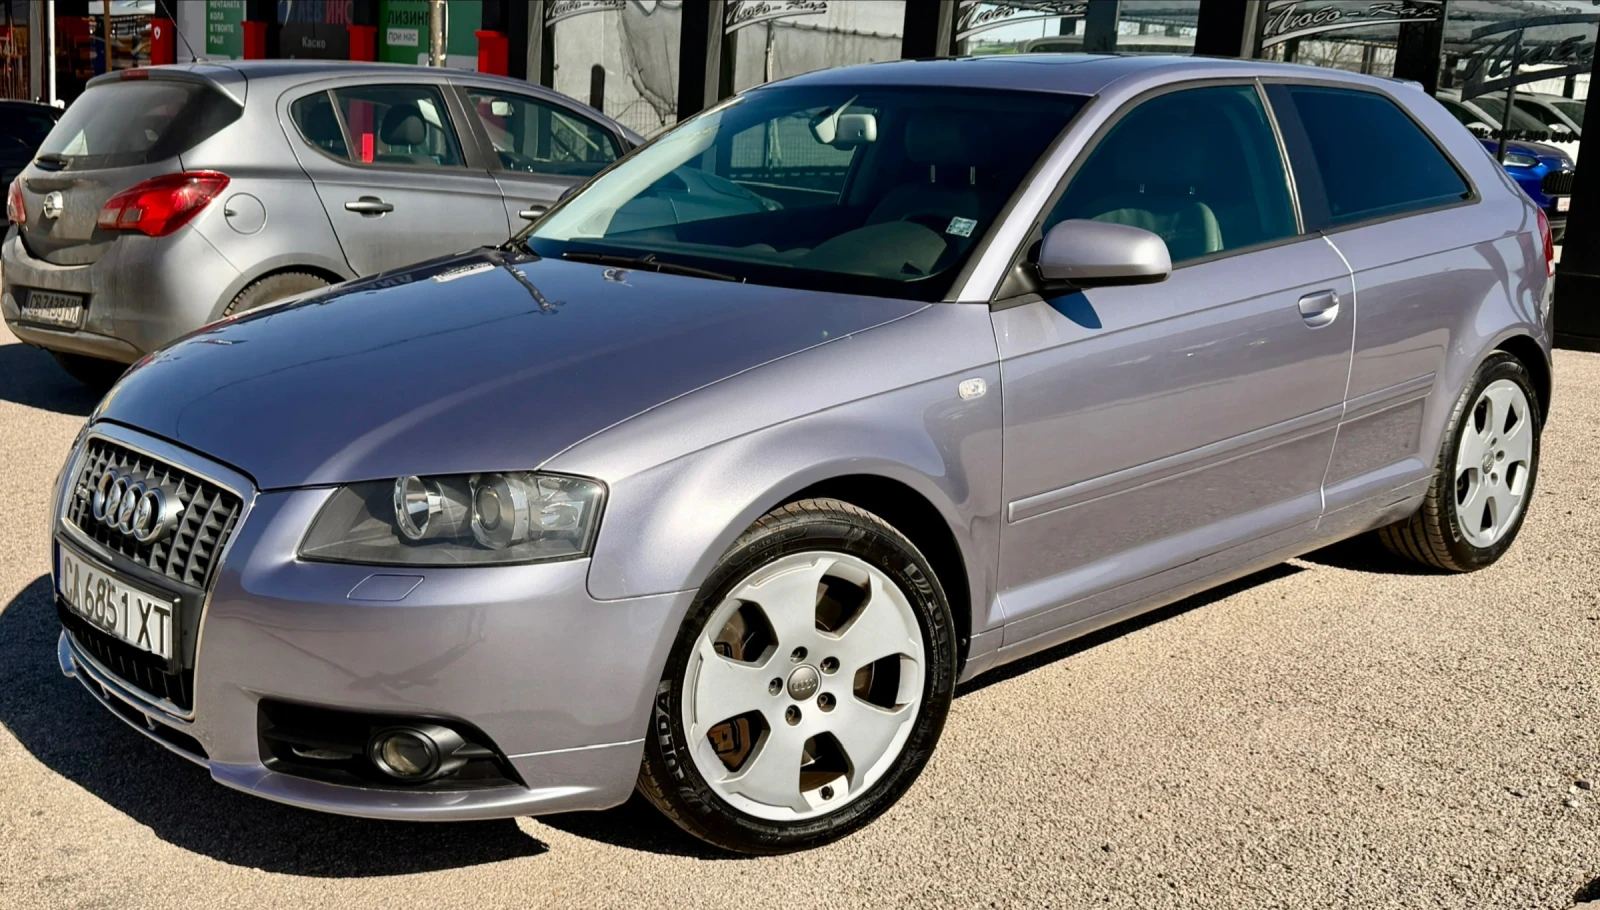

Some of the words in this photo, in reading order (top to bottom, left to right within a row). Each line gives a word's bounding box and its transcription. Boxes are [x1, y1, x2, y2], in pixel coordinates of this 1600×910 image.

[210, 12, 225, 20] КОЛА
[389, 32, 402, 42] при
[403, 32, 416, 42] нас
[302, 36, 326, 49] Каско
